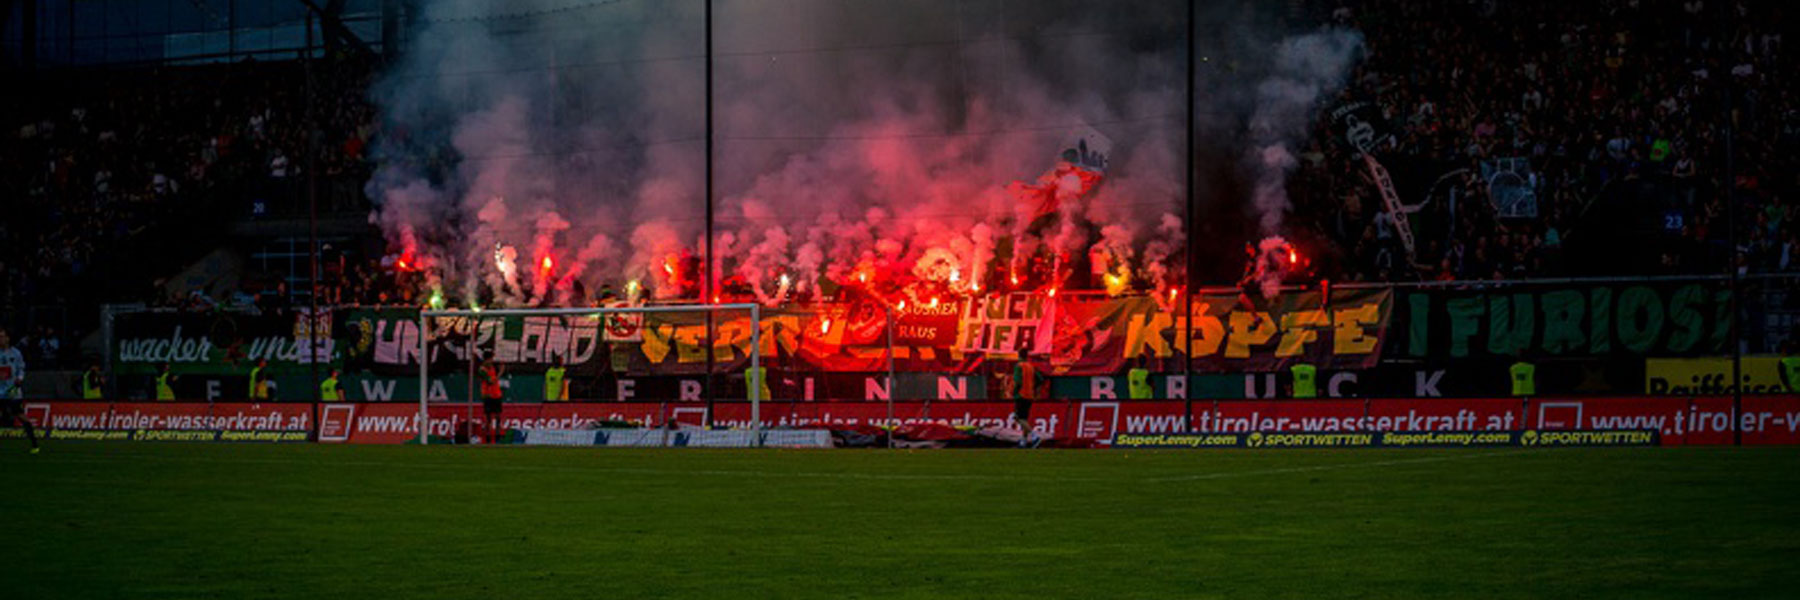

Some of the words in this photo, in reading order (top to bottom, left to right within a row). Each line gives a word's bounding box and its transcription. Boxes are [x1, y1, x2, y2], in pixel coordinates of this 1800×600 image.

[1665, 215, 1683, 229] 23
[899, 325, 938, 341] RAUS
[1124, 302, 1380, 359] KÖPFE
[118, 323, 211, 362] wacker
[51, 410, 309, 431] www.tiroler-wasserkraft.at
[1125, 408, 1515, 434] www.tiroler-wasserkraft.at
[1115, 433, 1237, 447] SuperLenny.com
[1265, 433, 1373, 445] SPORTWETTEN
[1381, 432, 1512, 445] SuperLenny.com
[1538, 431, 1651, 445] SPORTWETTEN
